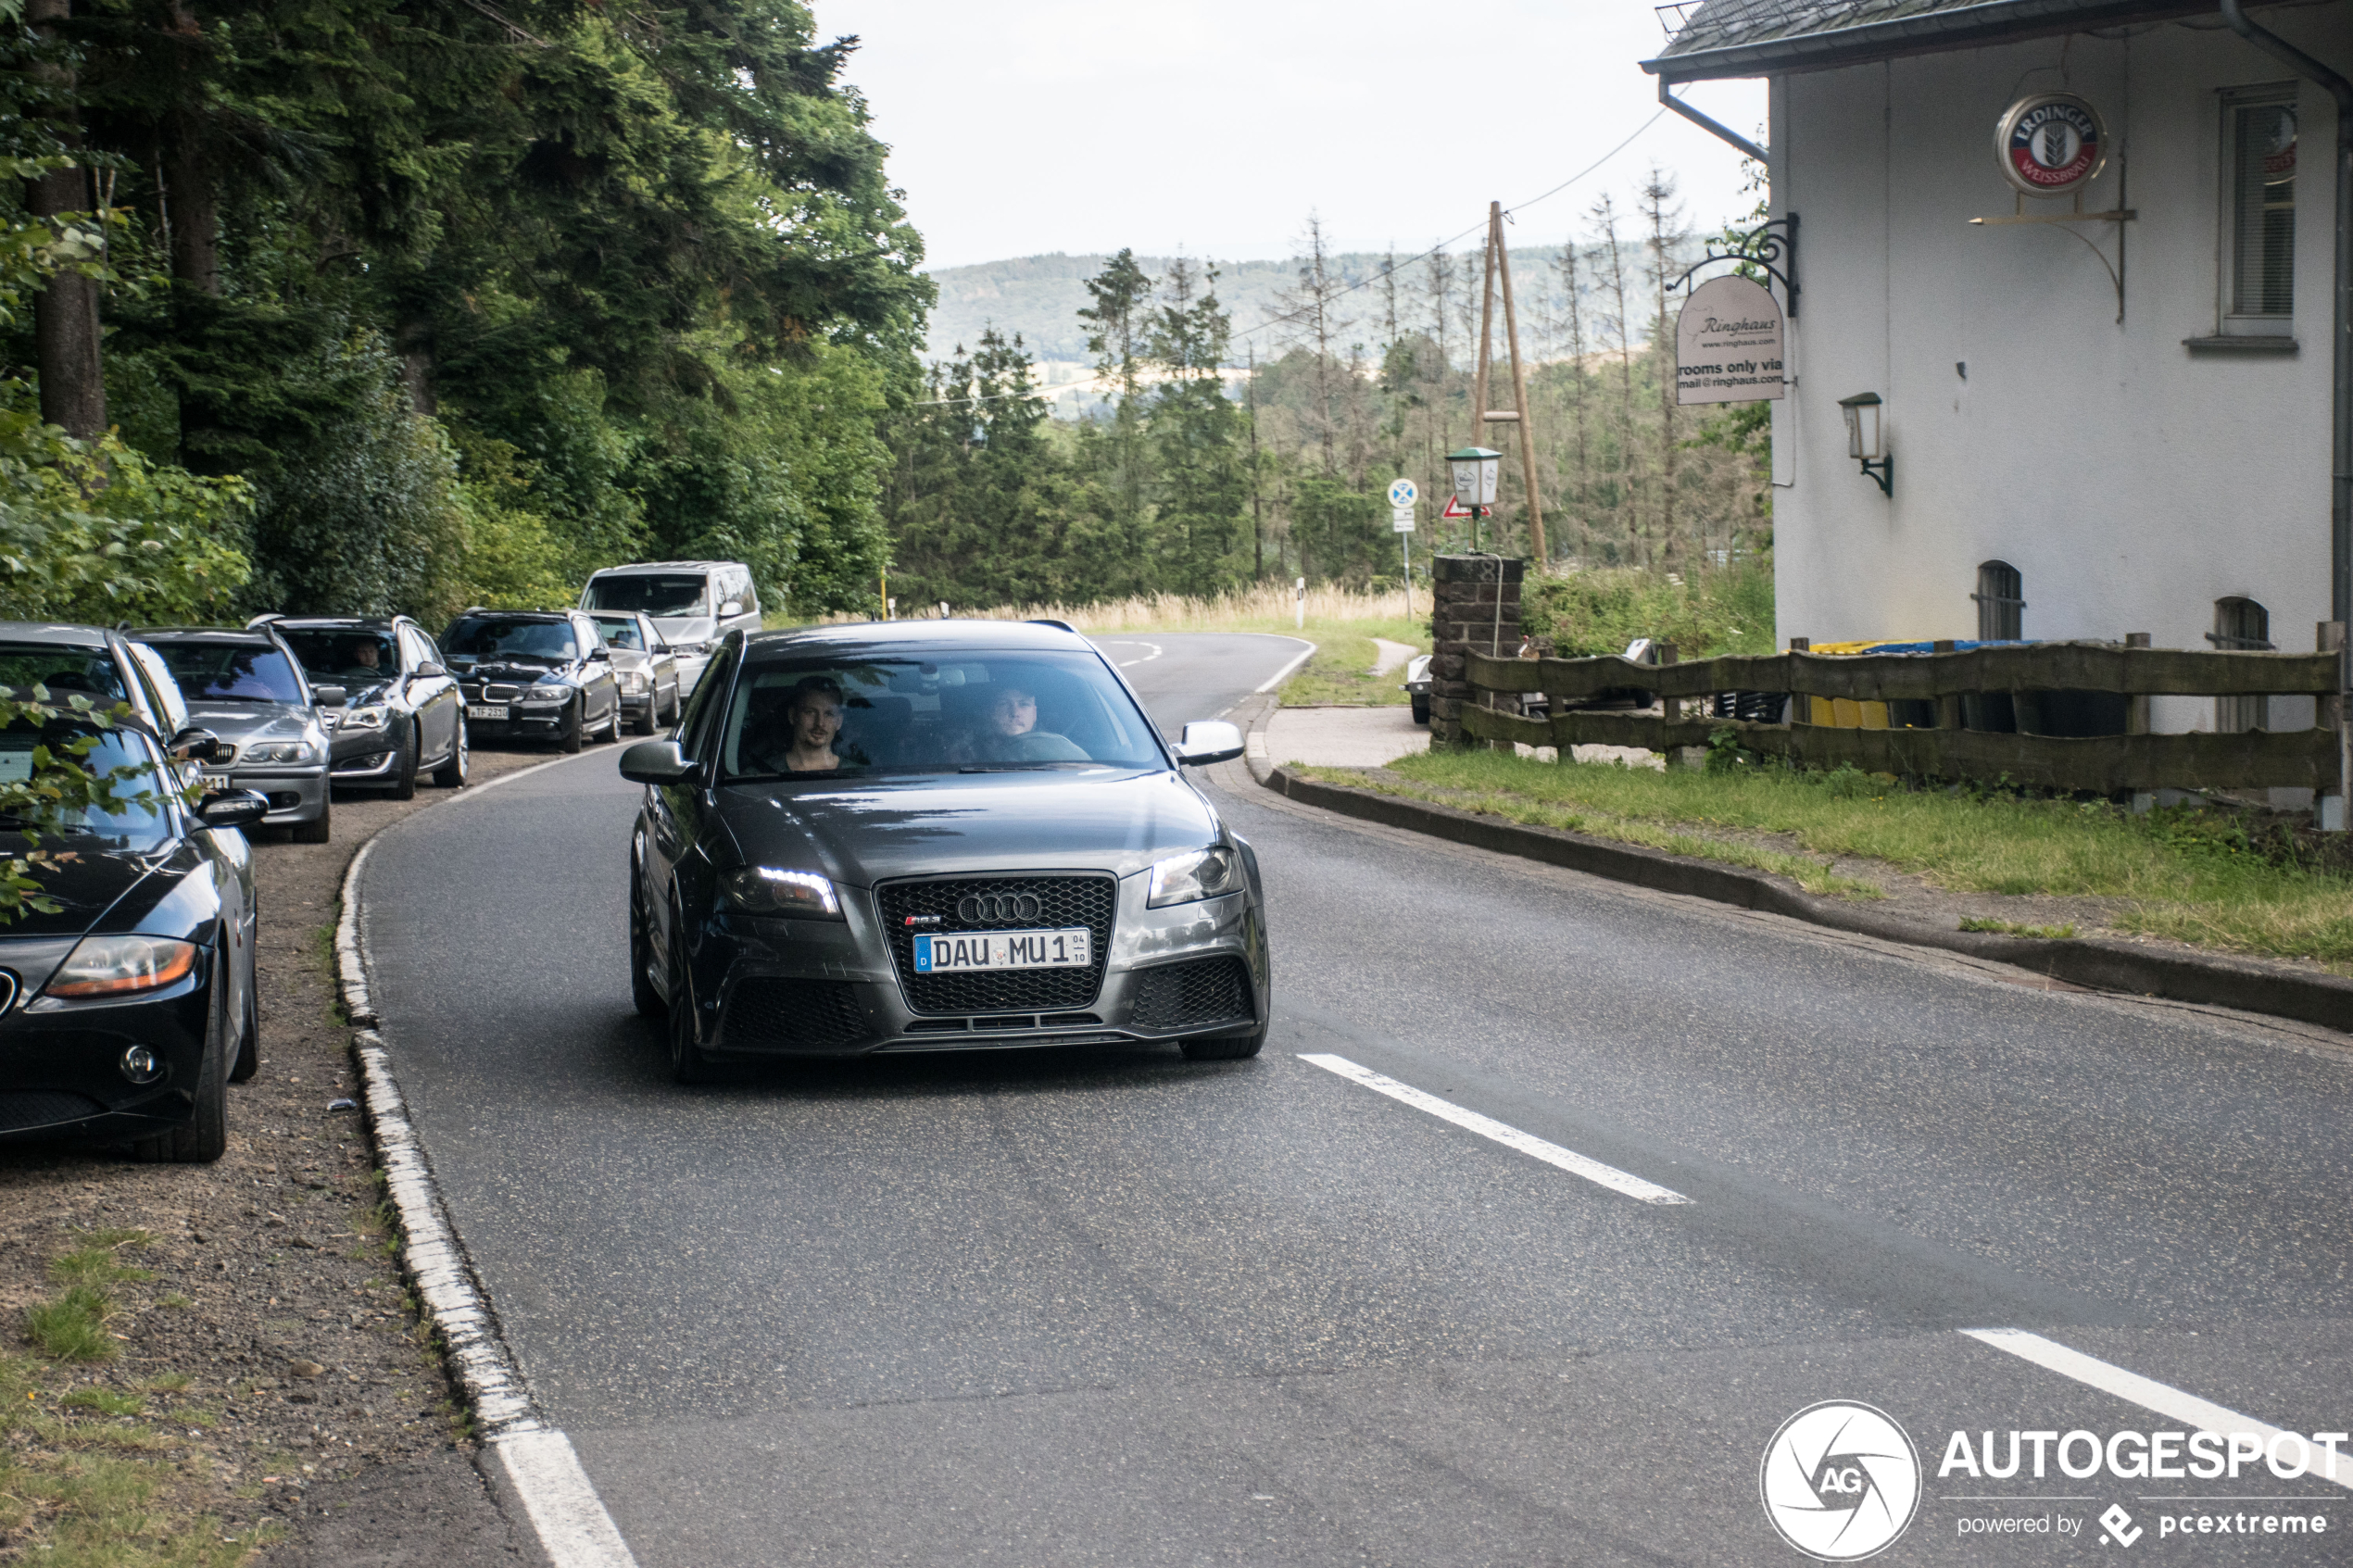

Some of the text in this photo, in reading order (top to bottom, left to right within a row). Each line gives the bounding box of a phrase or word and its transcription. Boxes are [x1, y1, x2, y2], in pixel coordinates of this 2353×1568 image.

[2015, 106, 2093, 141] ERDINGER
[1702, 317, 1776, 336] Ringhaus
[1702, 338, 1776, 348] www.ringhaus.com
[1679, 358, 1783, 376] rooms only via
[1073, 935, 1085, 944] 04
[934, 935, 1069, 967] DAU MU 1
[1075, 953, 1086, 962] 10
[920, 957, 927, 966] D
